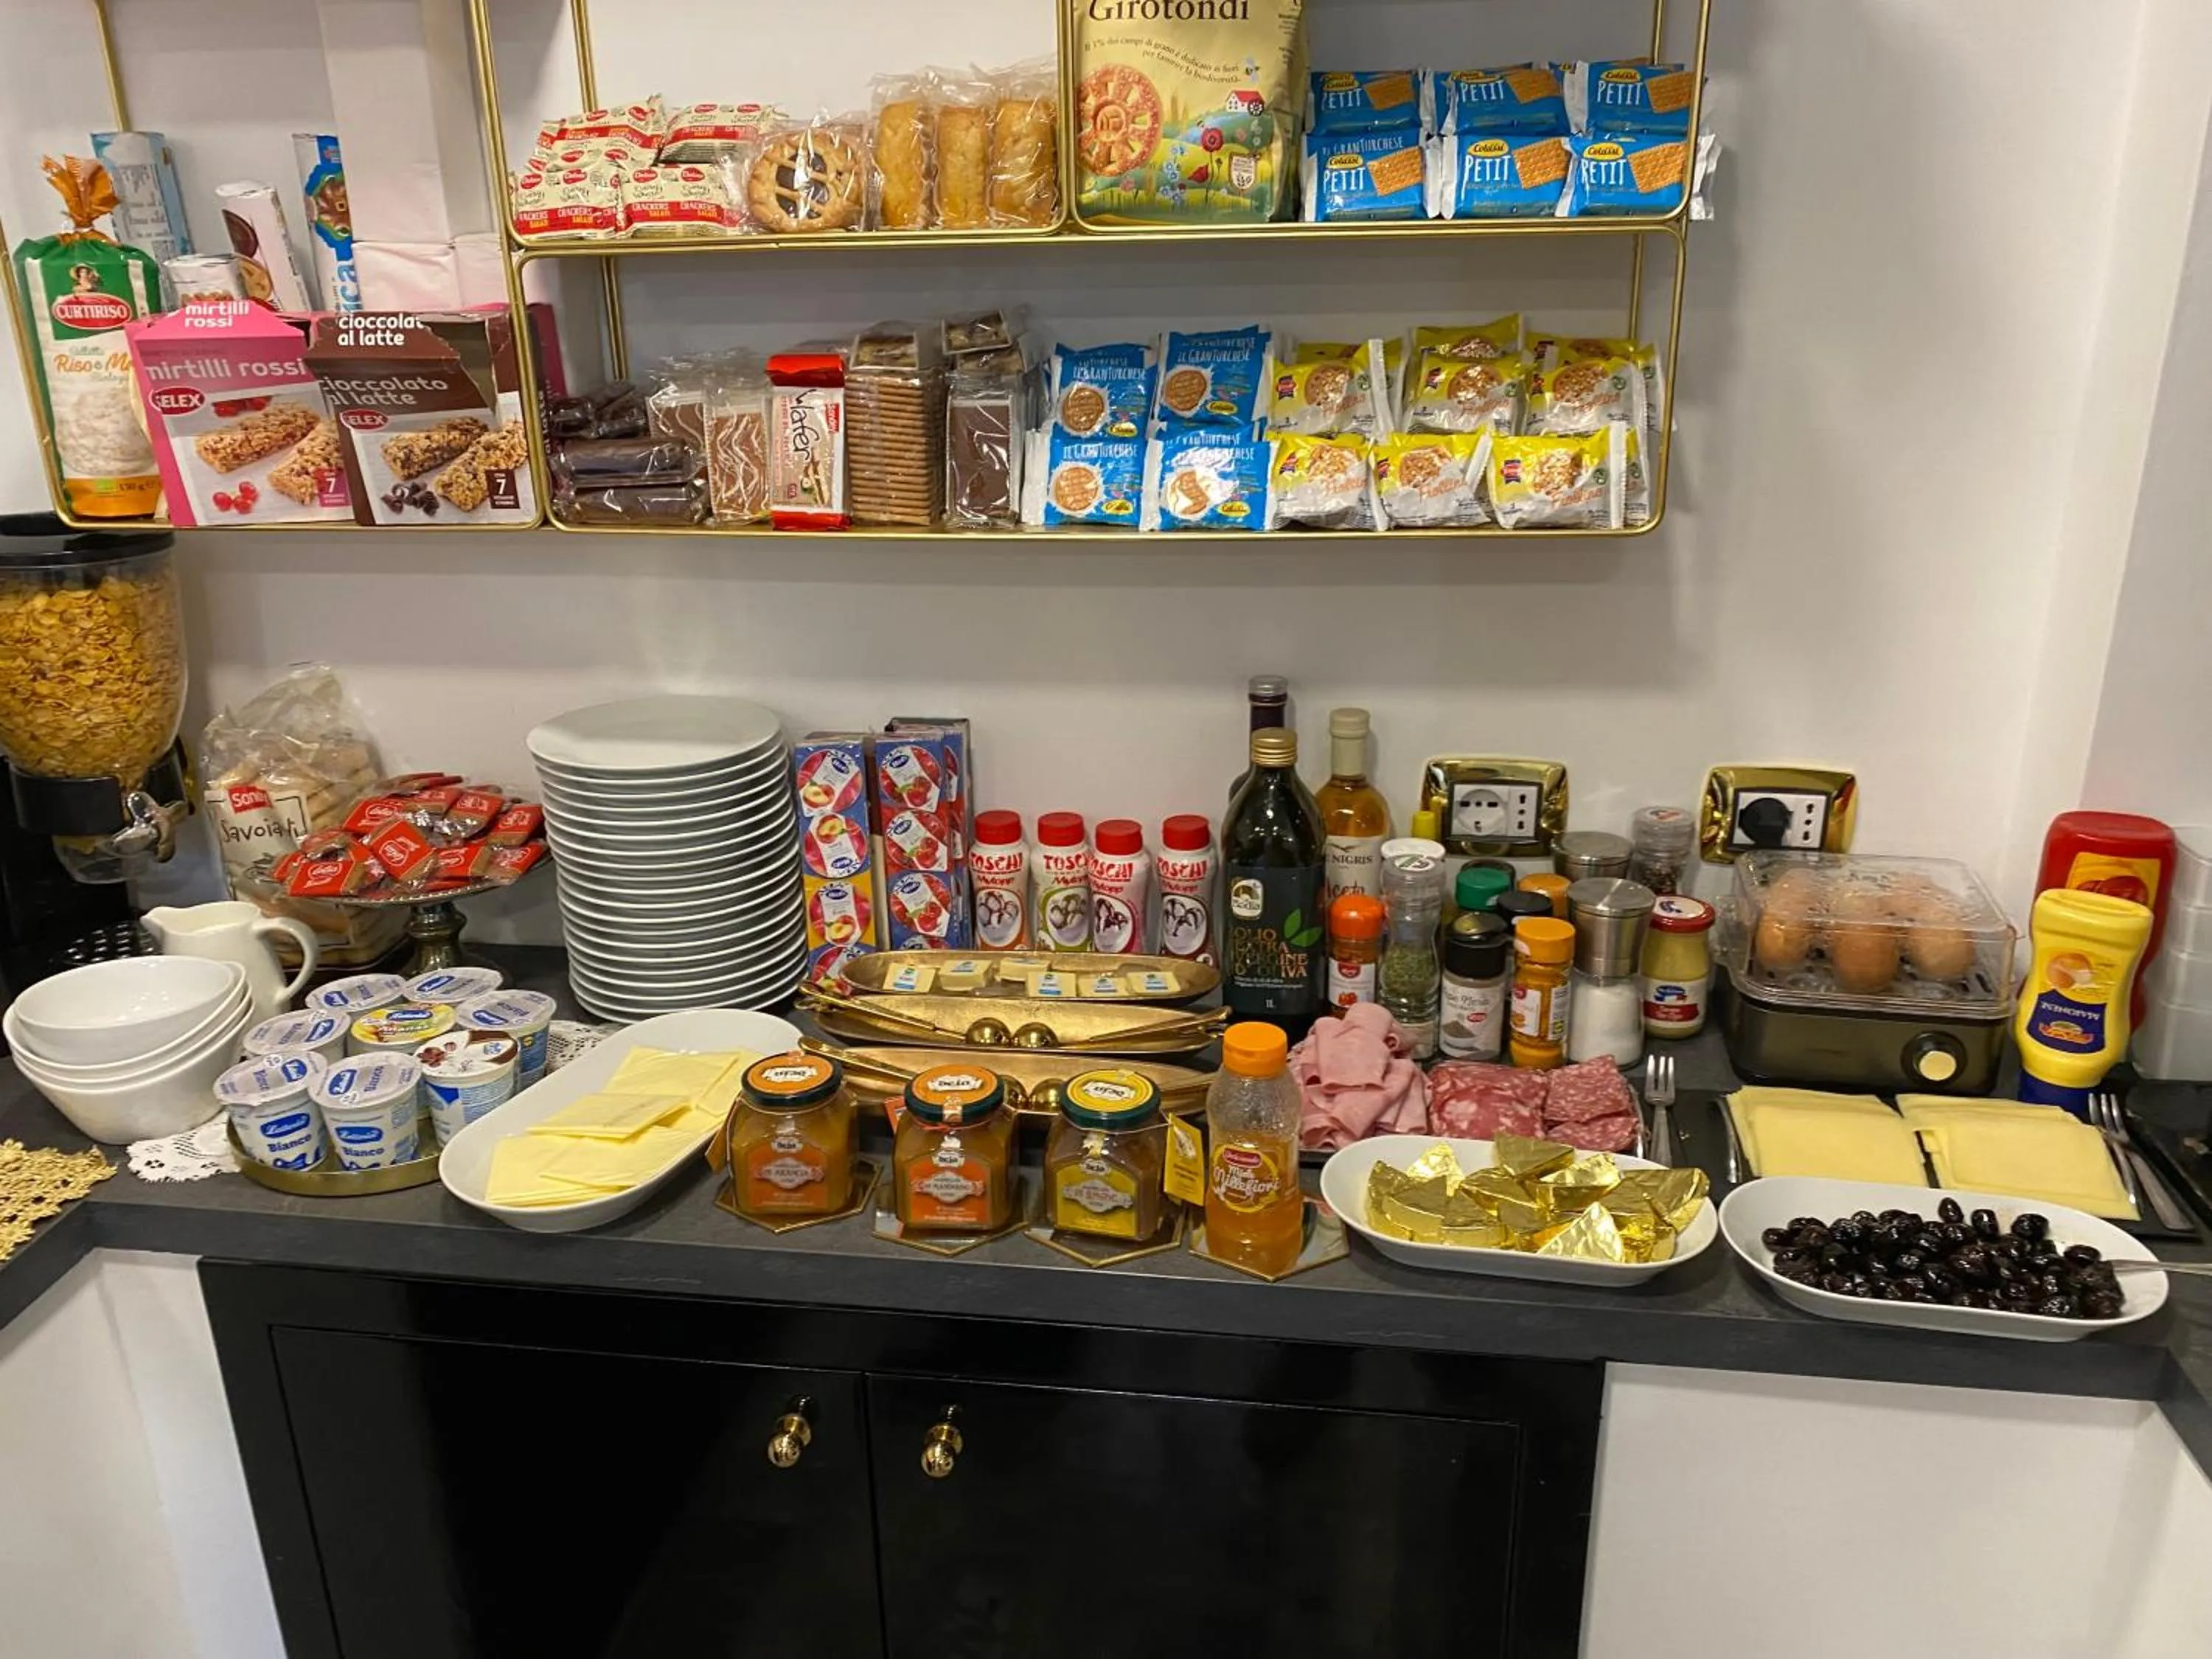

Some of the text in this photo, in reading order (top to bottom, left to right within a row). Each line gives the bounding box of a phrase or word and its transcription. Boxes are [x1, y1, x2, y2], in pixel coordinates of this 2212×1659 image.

[1088, 0, 1249, 20] Girotondi
[1461, 80, 1506, 102] PETIT
[1598, 80, 1644, 105] PETIT
[1461, 155, 1512, 186] PETIT
[1323, 167, 1365, 192] PETIT
[55, 304, 128, 319] CURTIRISO
[185, 302, 249, 316] mirtilli
[185, 316, 232, 328] rossi
[338, 314, 425, 330] cioccolat
[338, 330, 406, 346] al latte
[54, 353, 93, 372] Riso
[146, 358, 232, 380] mirtilli
[238, 358, 307, 377] rossi
[321, 377, 449, 392] cioccolato
[154, 394, 201, 408] SELEX
[354, 391, 417, 406] latte
[324, 478, 337, 493] 7
[496, 479, 507, 495] 7
[971, 852, 1022, 871] TOSCHI
[1044, 854, 1089, 870] TOSC
[1156, 855, 1206, 877] TOSCHI
[1332, 855, 1373, 863] NIGRIS
[2040, 1001, 2101, 1020] MAIONESE
[268, 1134, 312, 1152] Bianco
[342, 1147, 385, 1157] Bianco
